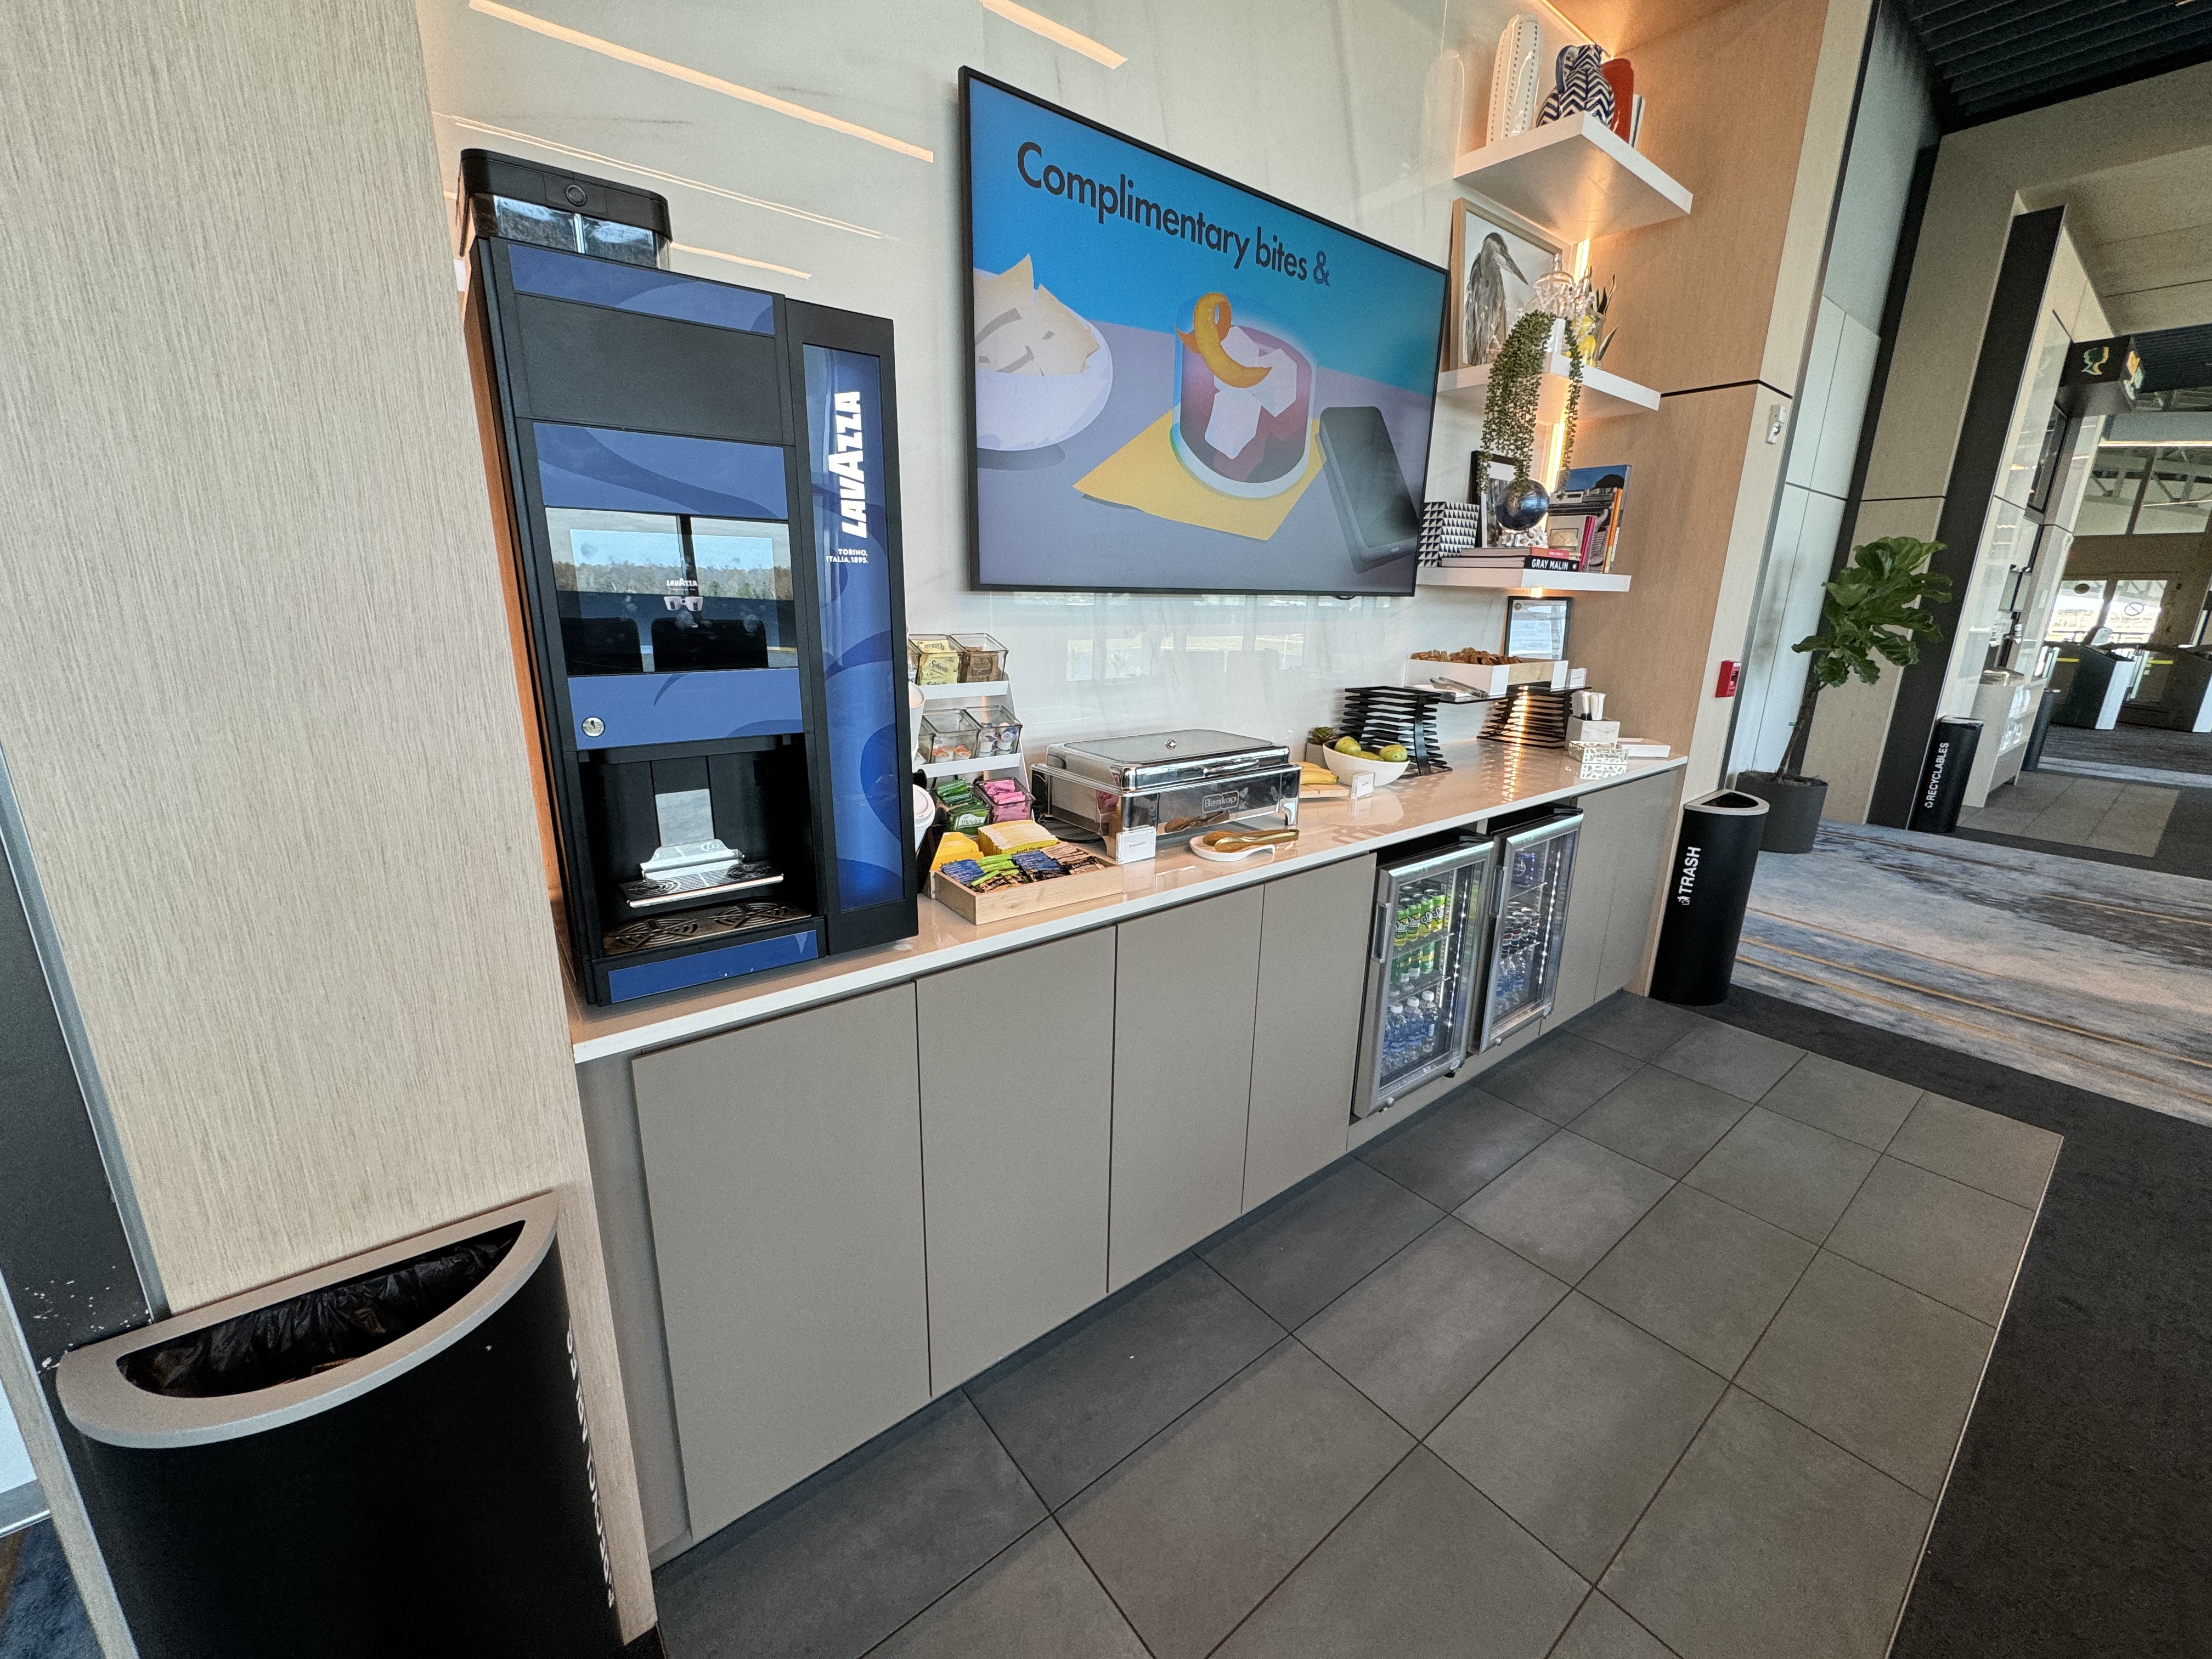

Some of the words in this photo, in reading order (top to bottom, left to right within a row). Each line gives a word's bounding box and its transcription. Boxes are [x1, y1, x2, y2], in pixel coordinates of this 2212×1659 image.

[1018, 142, 1250, 269] Complimentary
[1256, 227, 1307, 280] bites
[1313, 251, 1330, 286] &
[828, 391, 867, 539] LAVAZZA
[666, 578, 698, 586] LAVAZZA
[1531, 558, 1548, 568] GRAY
[1549, 560, 1569, 571] MALIN
[1926, 742, 1949, 802] RECYCLABLES
[1678, 847, 1701, 894] TRASH
